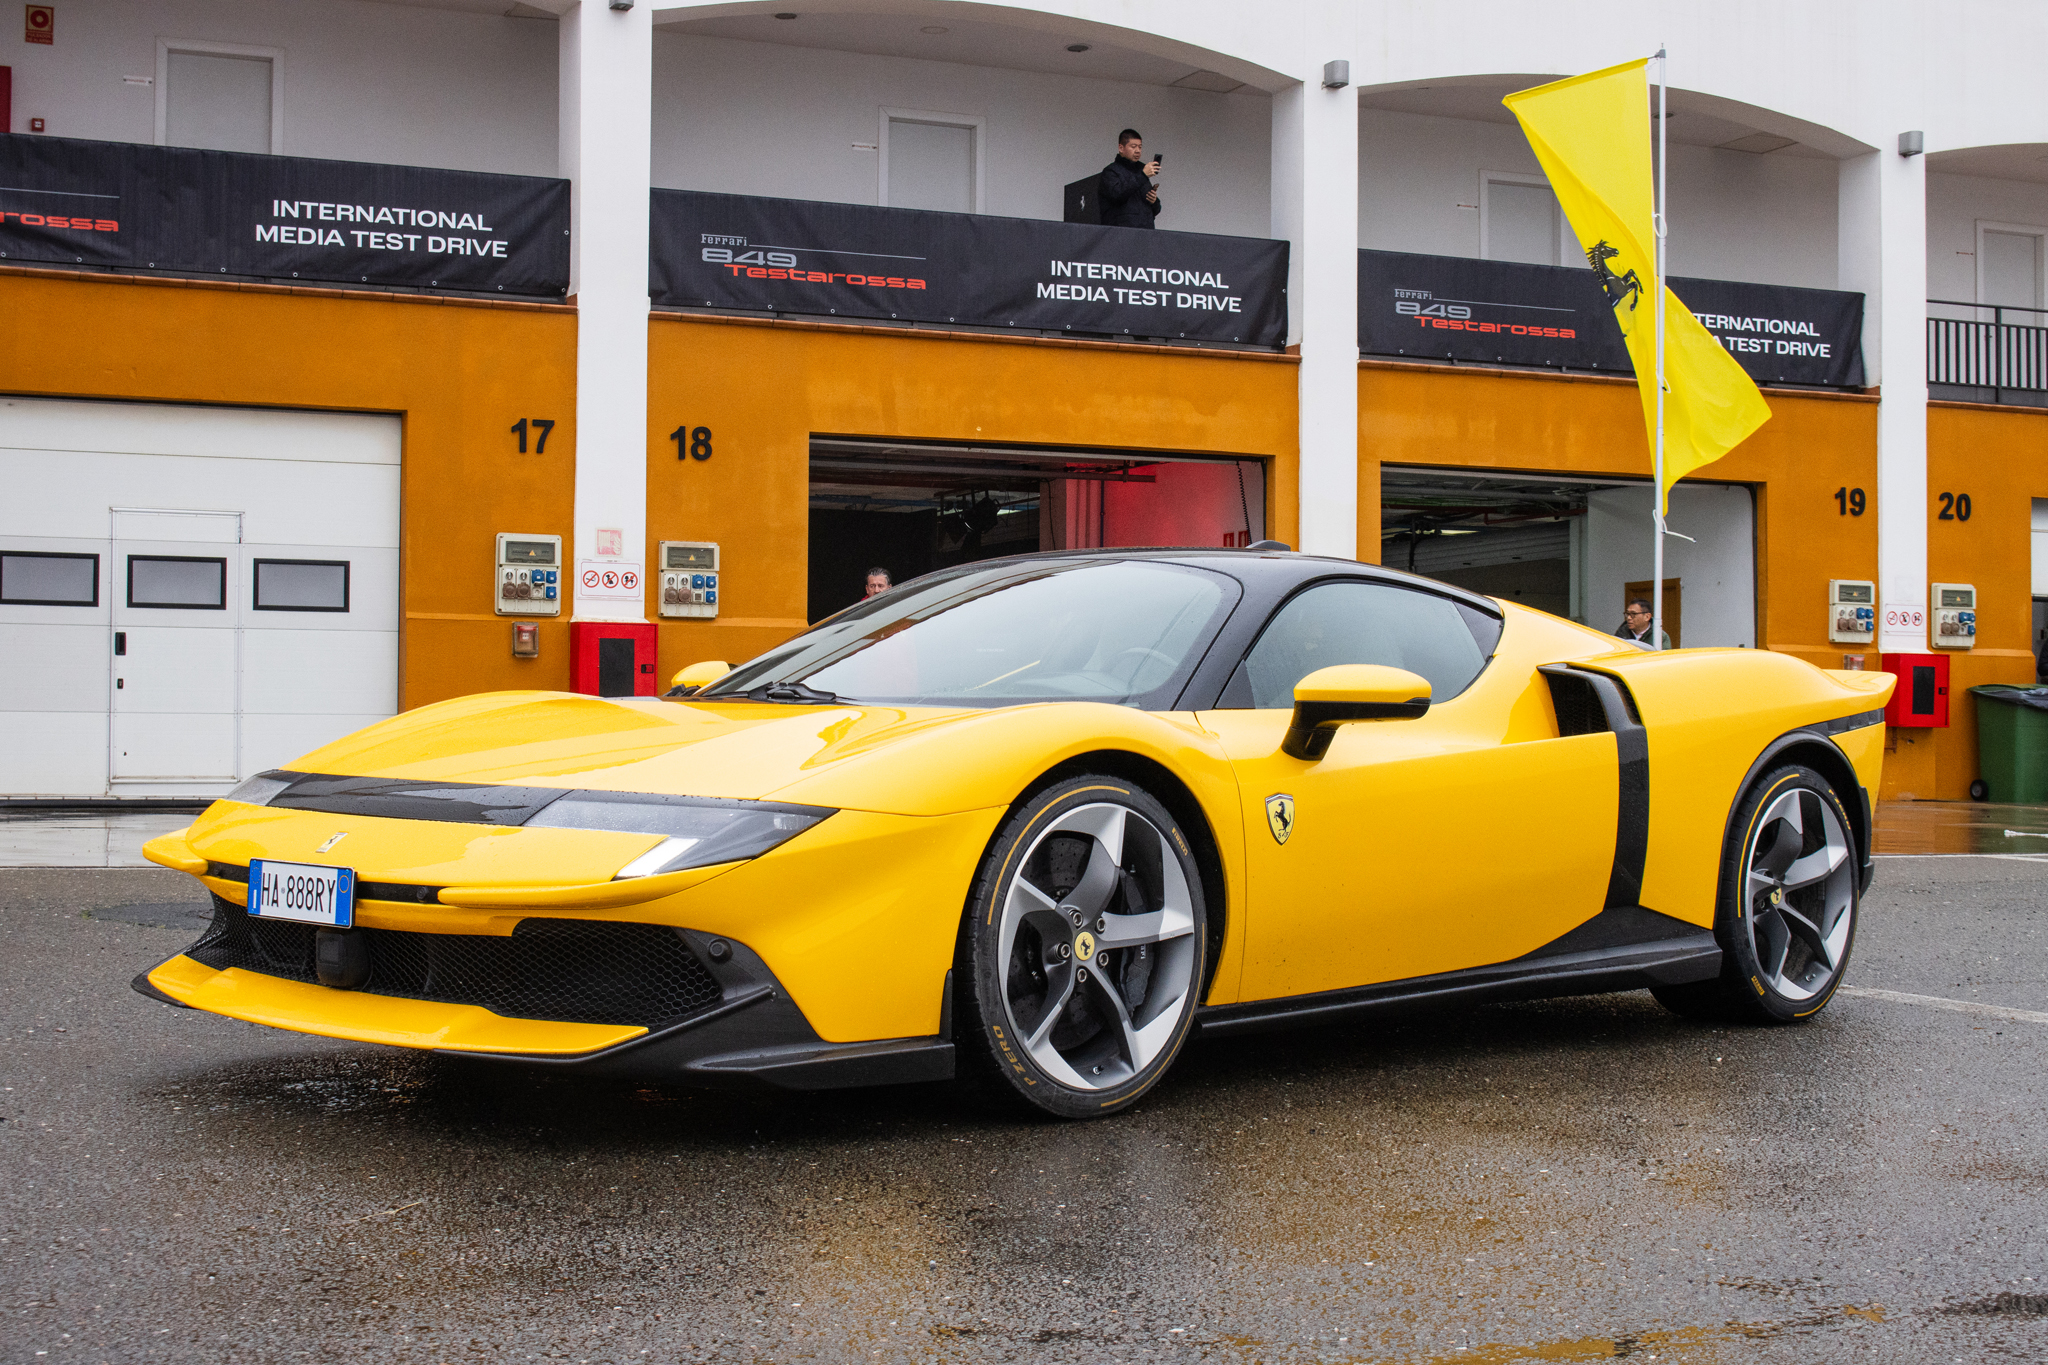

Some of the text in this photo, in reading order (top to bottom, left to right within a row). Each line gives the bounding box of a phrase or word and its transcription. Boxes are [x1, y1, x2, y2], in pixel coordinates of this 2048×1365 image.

[0, 211, 119, 232] rossa
[273, 200, 493, 232] INTERNATIONAL
[255, 224, 508, 258] MEDIA TEST DRIVE
[700, 233, 748, 247] Ferrari
[701, 247, 797, 268] 849
[724, 263, 927, 290] Testarossa
[1051, 260, 1229, 289] INTERNATIONAL
[1036, 282, 1242, 313] MEDIA TEST DRIVE
[1394, 288, 1433, 300] Ferrari
[1395, 301, 1471, 320] 849
[1692, 312, 1821, 337] TERNATIONAL
[1413, 315, 1576, 339] Testarossa
[1725, 336, 1773, 354] TEST
[1776, 340, 1831, 358] DRIVE
[511, 417, 555, 454] 17
[670, 425, 713, 461] 18
[1834, 486, 1866, 516] 19
[1938, 491, 1972, 522] 20
[261, 872, 336, 914] HA 888RY
[992, 1025, 1037, 1086] P ZERO
